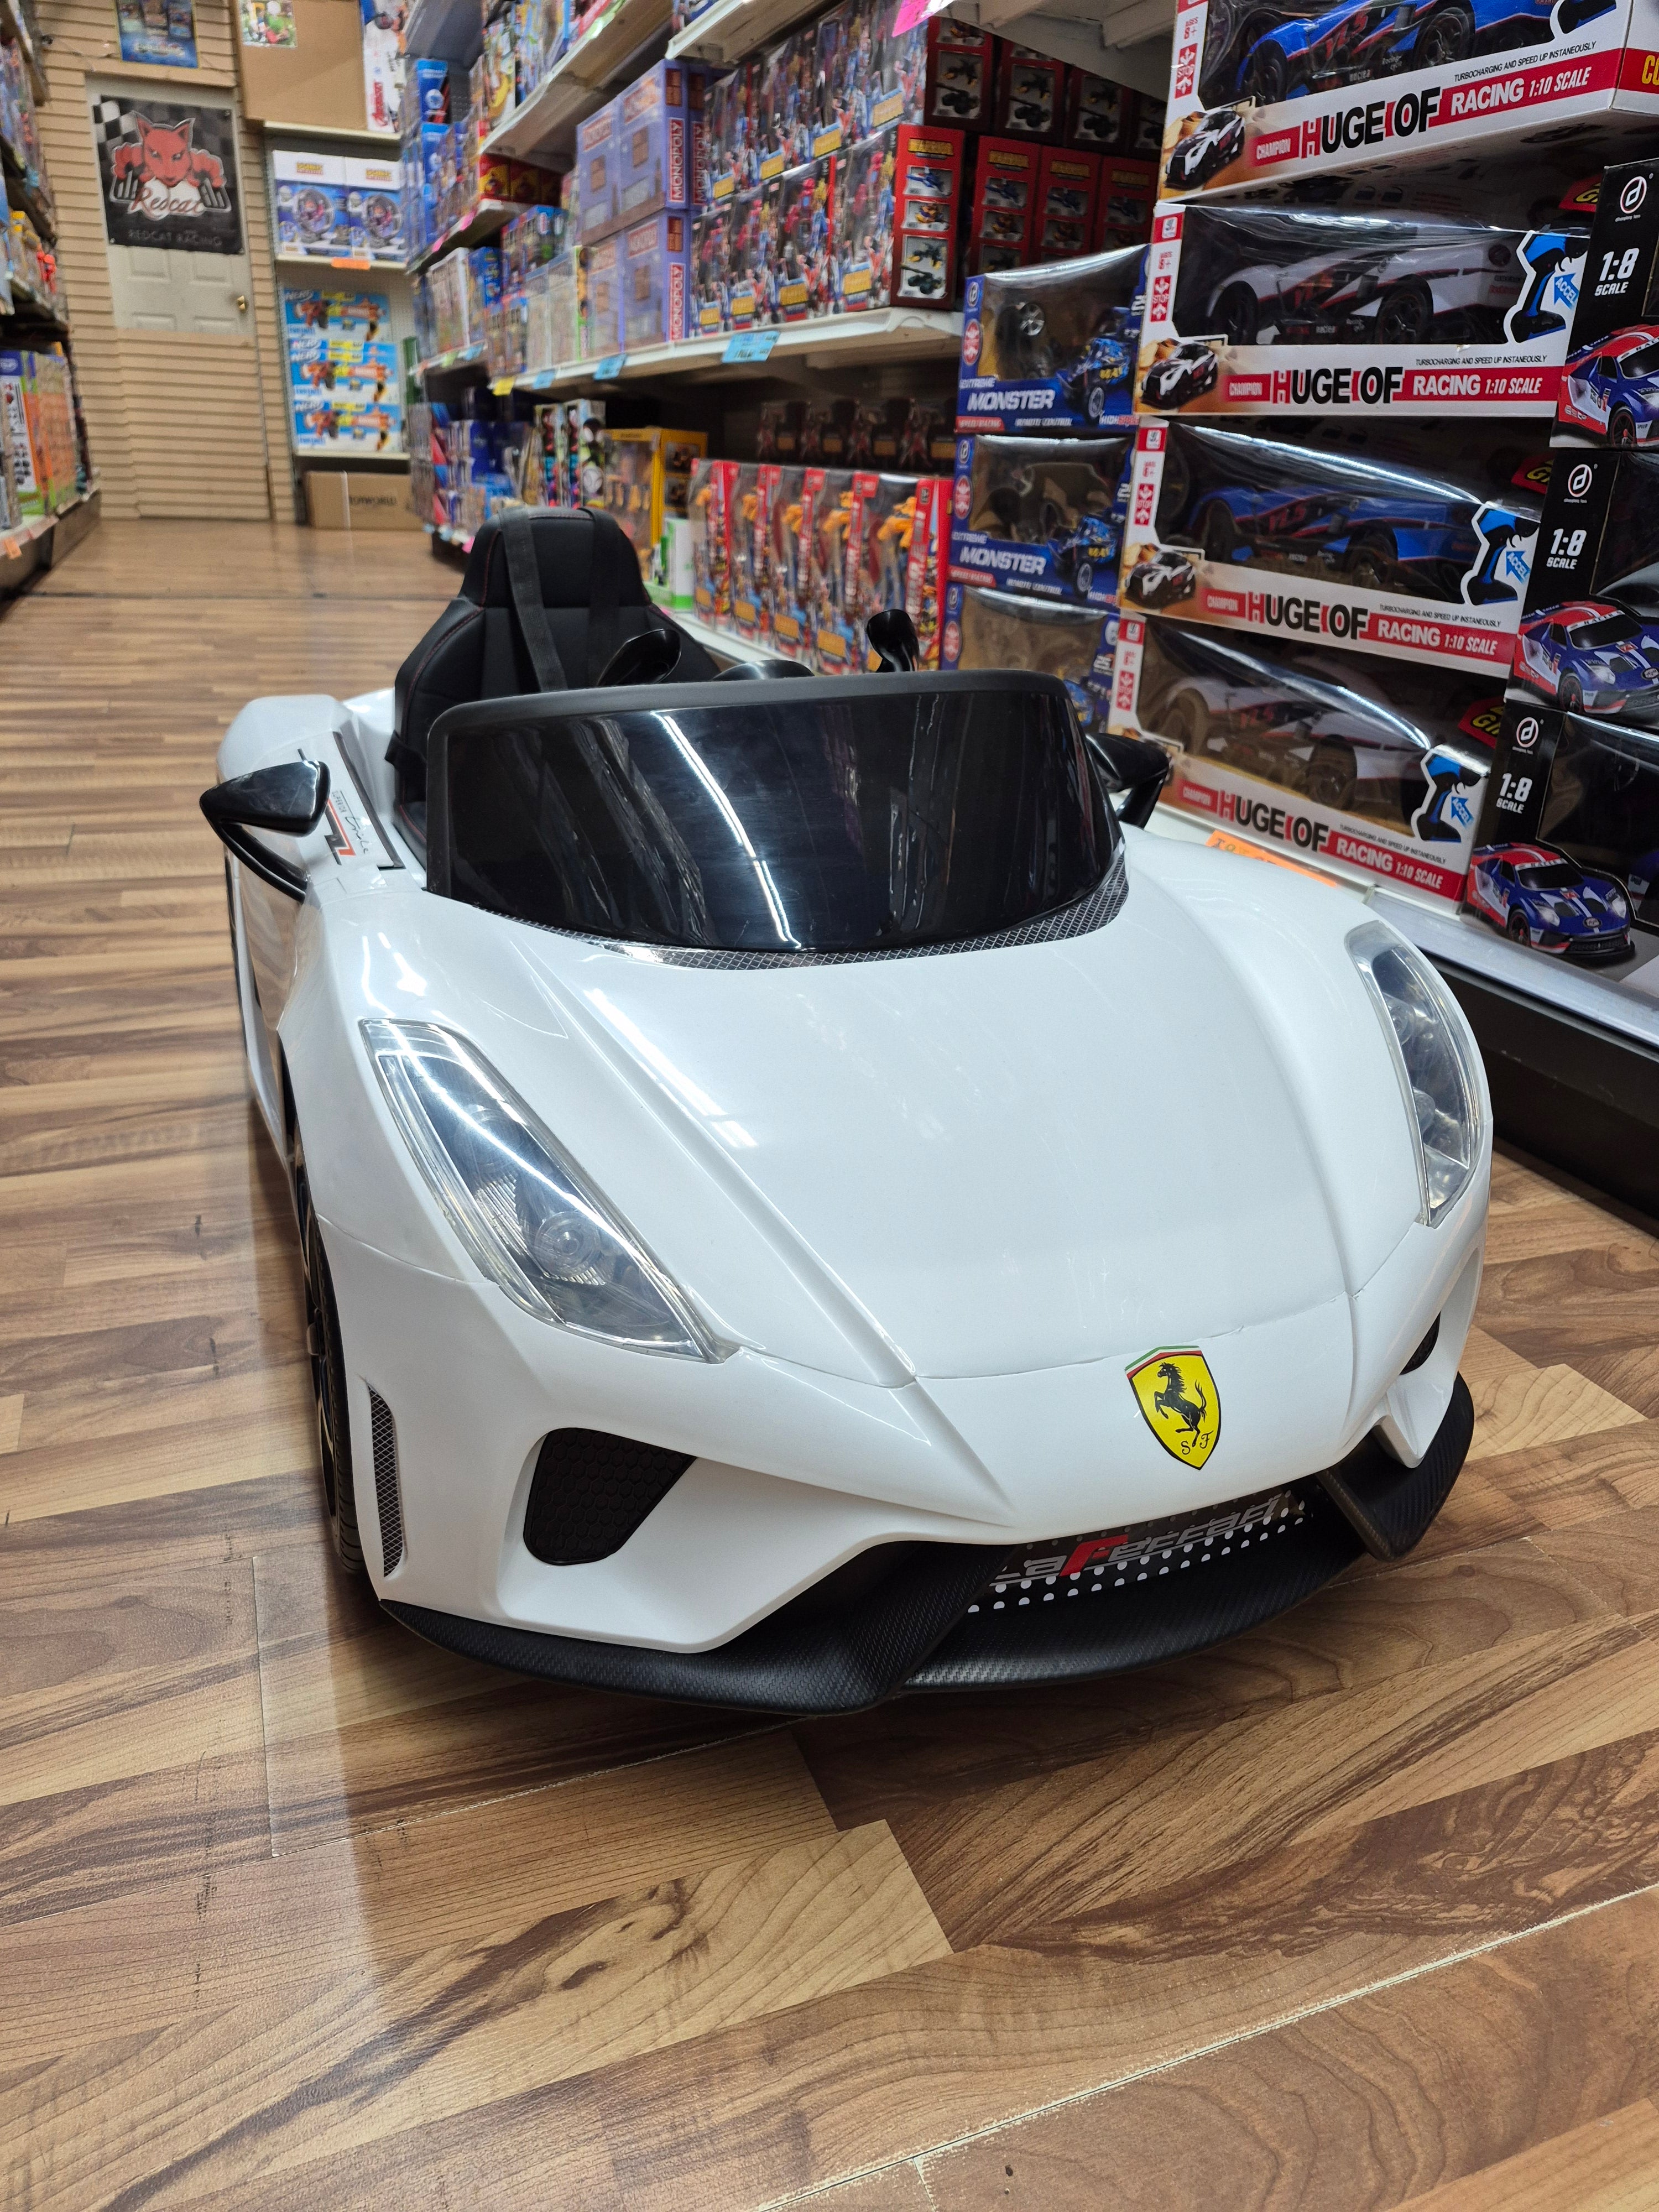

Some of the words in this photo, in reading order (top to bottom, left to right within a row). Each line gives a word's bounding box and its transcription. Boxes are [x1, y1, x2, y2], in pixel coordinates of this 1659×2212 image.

[1454, 64, 1502, 82] TURBOCHARGING
[1504, 59, 1516, 70] AND
[1517, 55, 1538, 66] SPEED
[1540, 52, 1548, 61] UP
[1549, 41, 1596, 59] INSTANEOUSLY
[1256, 138, 1291, 160] CHAMPION
[1451, 78, 1524, 116] RACING
[1529, 75, 1552, 97] 1:10
[1553, 66, 1592, 92] SCALE
[672, 122, 683, 199] MONOPOLY
[1599, 248, 1640, 281] 1:8
[673, 265, 682, 340] MONOPOLY
[1152, 294, 1170, 304] STOP
[1594, 281, 1629, 296] SCALE
[1229, 382, 1262, 396] CHAMPION
[1413, 374, 1481, 396] RACING
[1485, 378, 1507, 394] 1:10
[1508, 377, 1543, 394] SCALE
[967, 389, 1056, 411] MONSTER
[1551, 528, 1587, 556] 1:8
[960, 546, 1046, 576] MONSTER
[1546, 557, 1578, 570] SCALE
[1422, 609, 1433, 618] AND
[1433, 612, 1451, 620] SPEED
[1378, 619, 1441, 647] RACING
[1444, 633, 1465, 650] 1:10
[1465, 636, 1498, 655] SCALE
[1499, 773, 1533, 802] 1:8
[1496, 797, 1525, 814] SCALE
[1337, 837, 1393, 873] RACING
[1395, 861, 1414, 879] 1:10
[1415, 868, 1444, 889] SCALE
